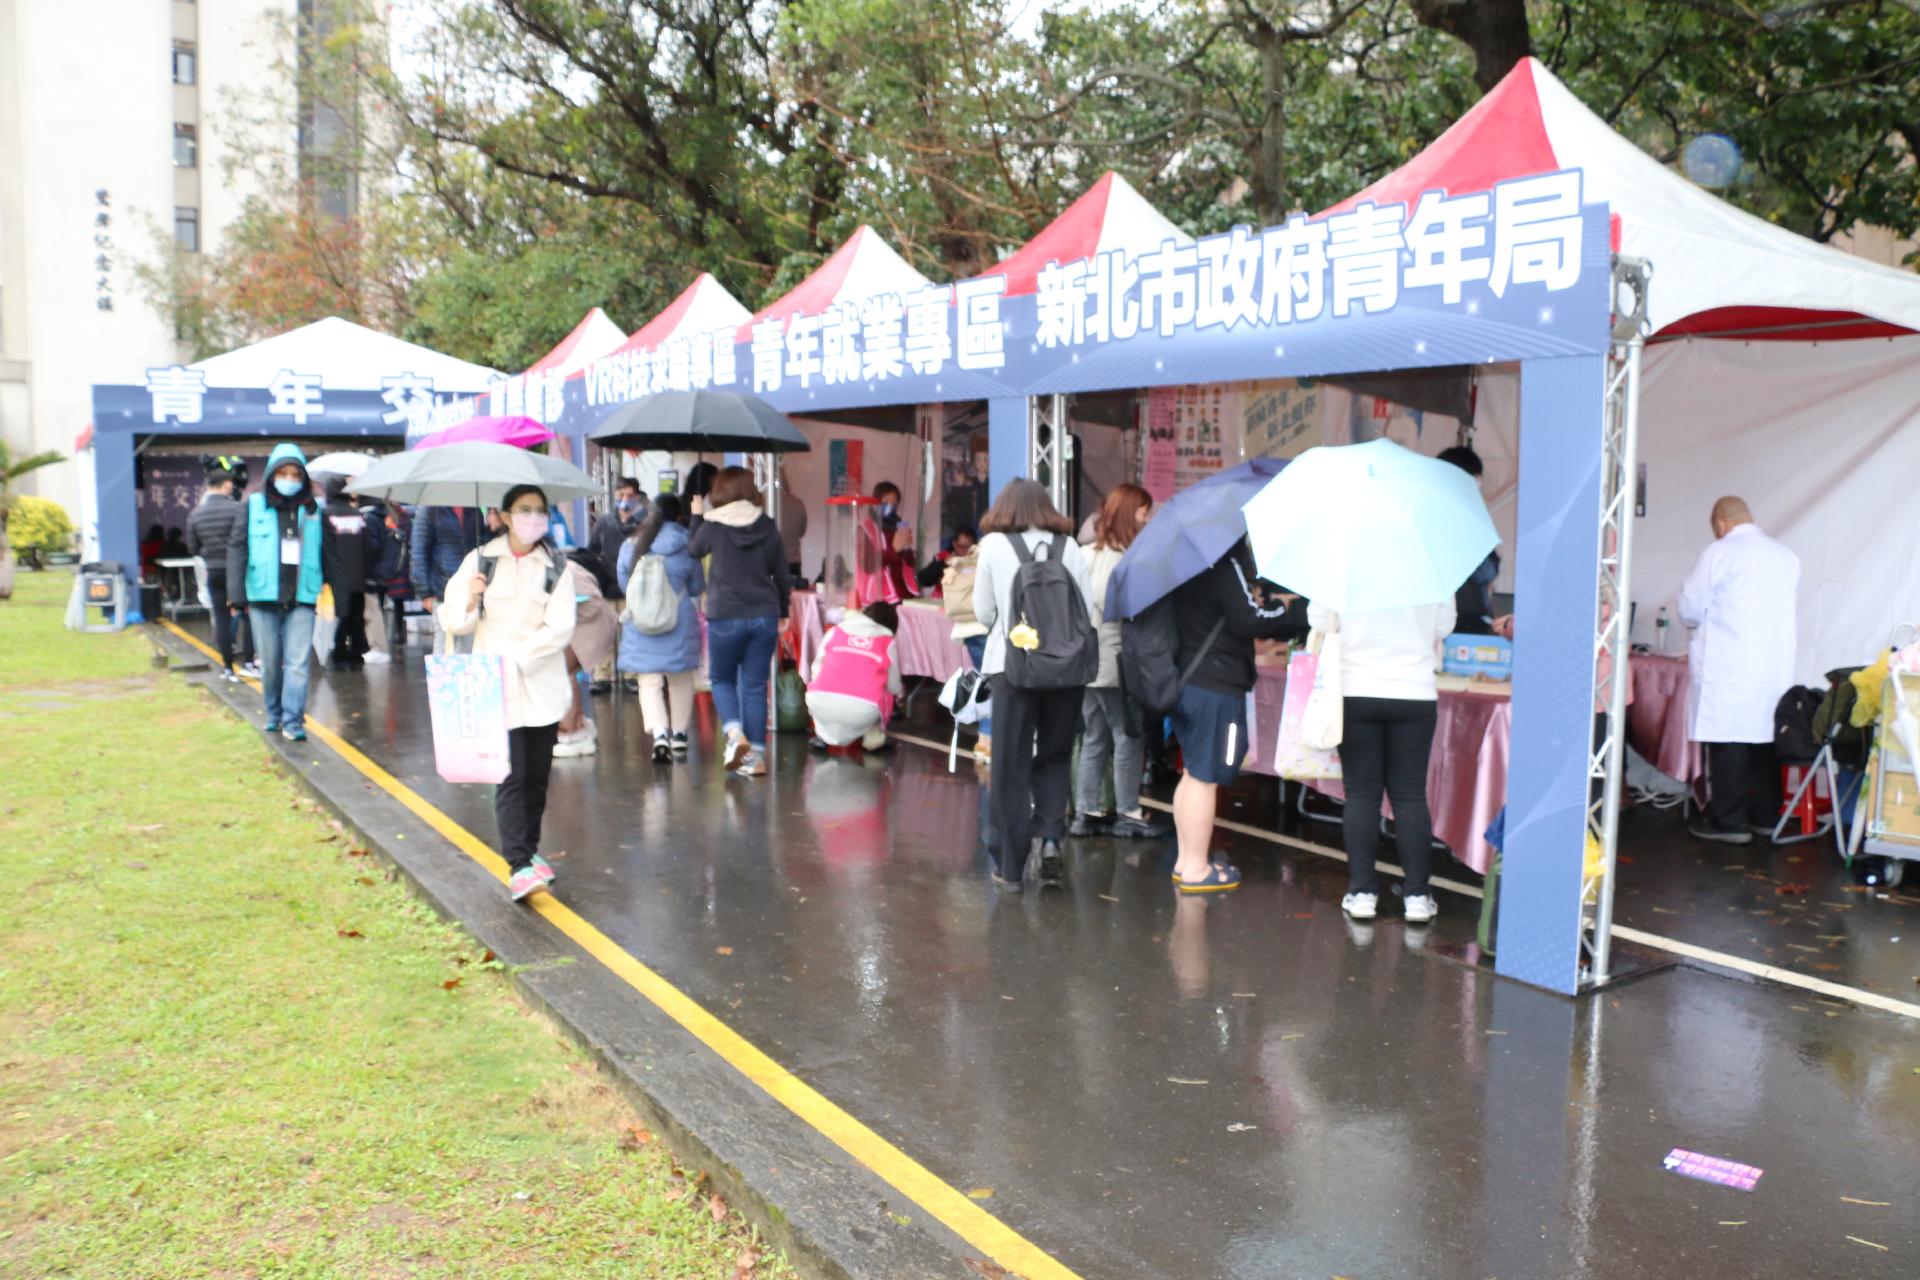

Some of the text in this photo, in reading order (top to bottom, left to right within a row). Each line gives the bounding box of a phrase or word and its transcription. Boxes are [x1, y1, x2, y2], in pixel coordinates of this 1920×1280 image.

[1034, 168, 1584, 348] 新北市政府青年局
[751, 276, 1006, 393] 青年就業專區
